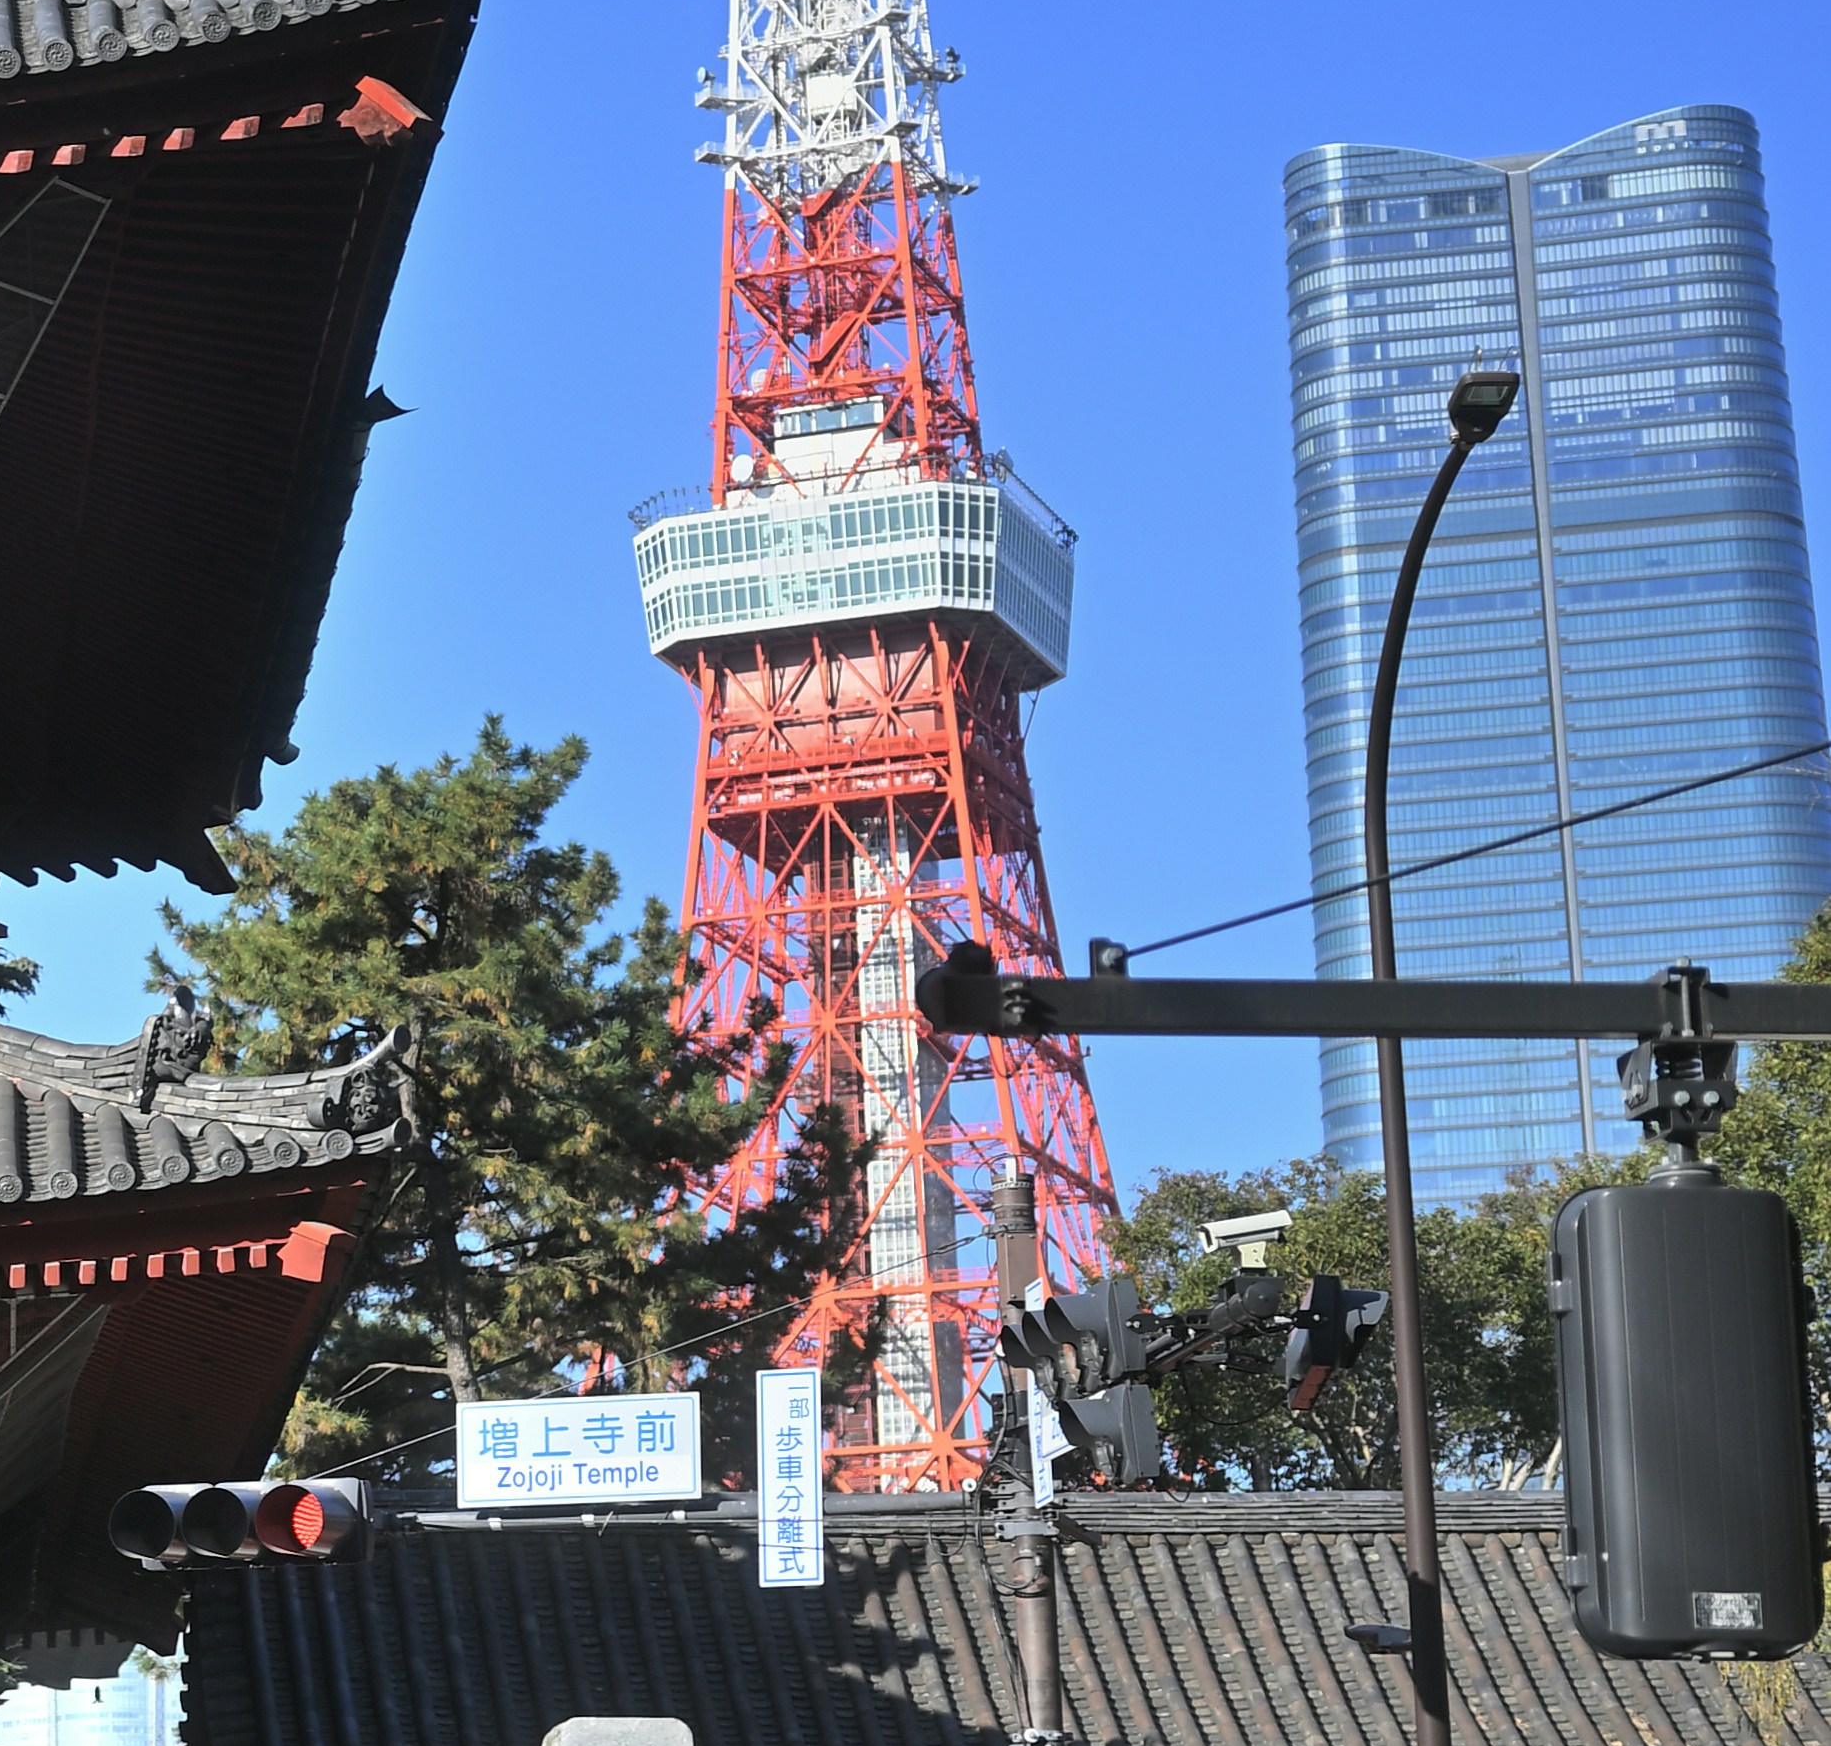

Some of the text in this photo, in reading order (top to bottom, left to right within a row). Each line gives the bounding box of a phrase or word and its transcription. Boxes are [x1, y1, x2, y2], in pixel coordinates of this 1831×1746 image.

[478, 1410, 676, 1459] 増上寺前
[497, 1461, 659, 1492] Zojoji Temple
[776, 1386, 810, 1575] 一部歩車分離式
